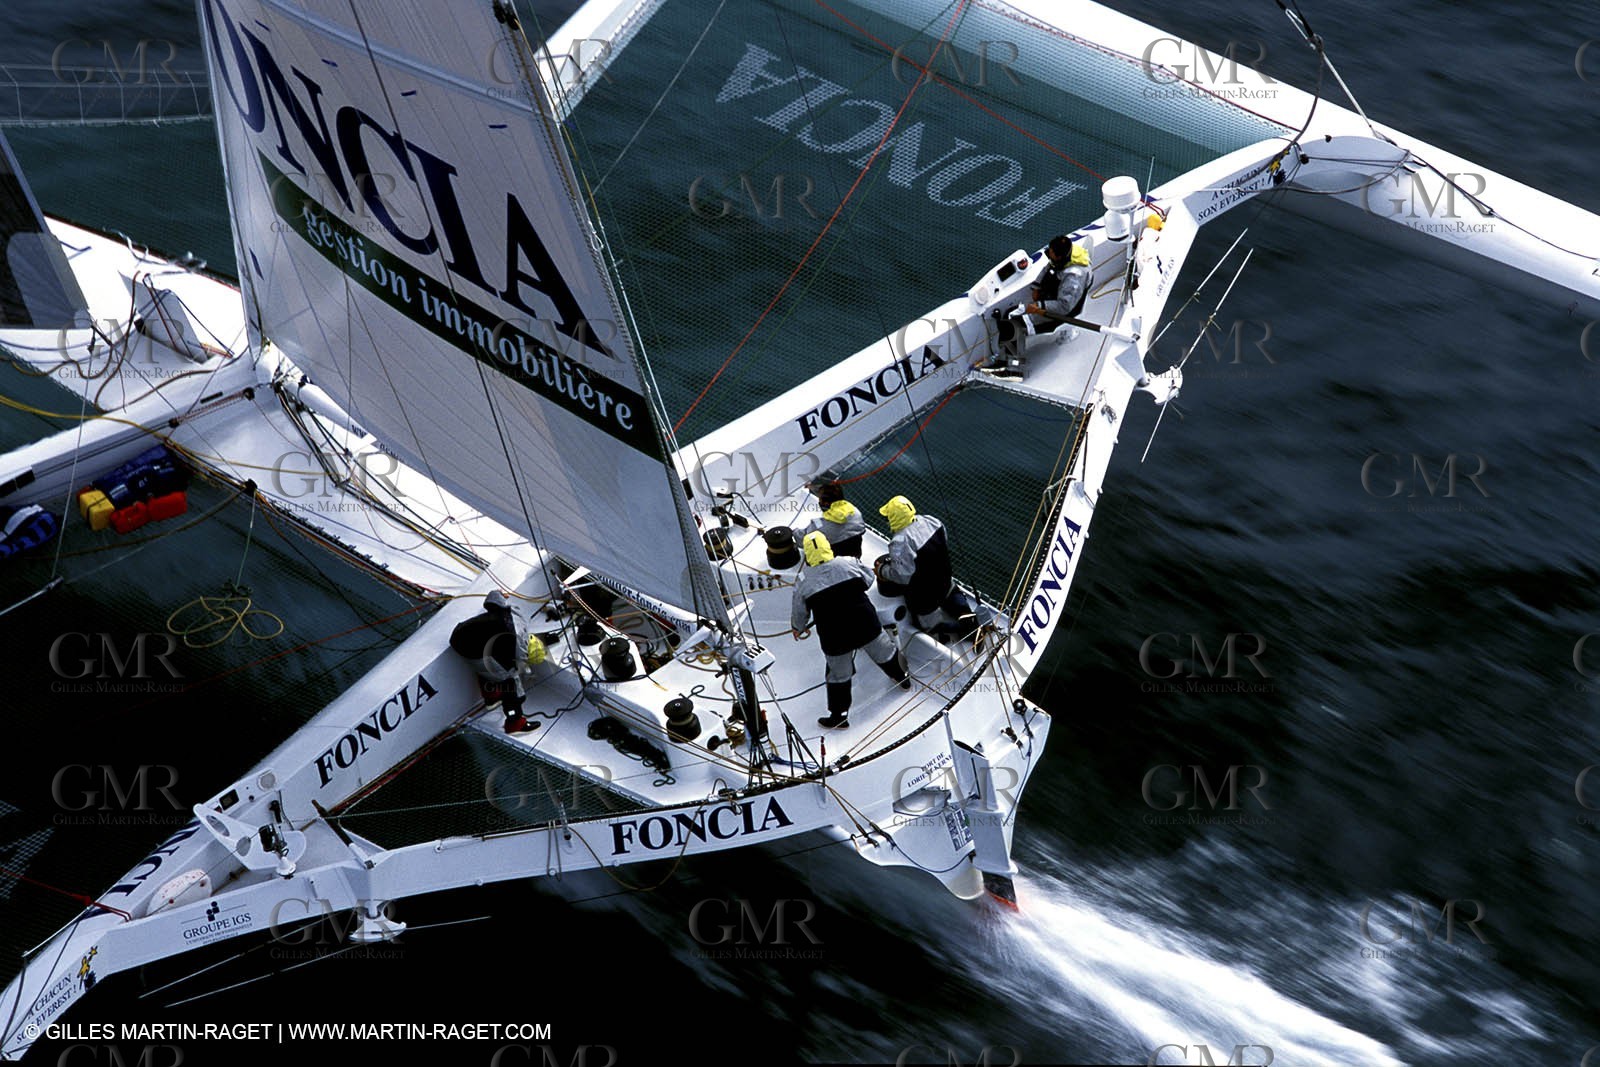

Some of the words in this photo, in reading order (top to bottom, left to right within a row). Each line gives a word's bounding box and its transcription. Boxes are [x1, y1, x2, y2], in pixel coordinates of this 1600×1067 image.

[1198, 203, 1217, 221] SON
[303, 204, 412, 304] gestion
[418, 279, 634, 431] immobilière
[795, 345, 946, 445] FONCIA
[1017, 515, 1082, 656] FONCIA
[314, 673, 439, 789] FONCIA
[609, 796, 794, 855] FONCIA
[183, 918, 231, 939] GROUPE
[232, 912, 252, 926] IGS
[35, 974, 72, 1011] CHACUN
[36, 987, 72, 1026] EVEREST
